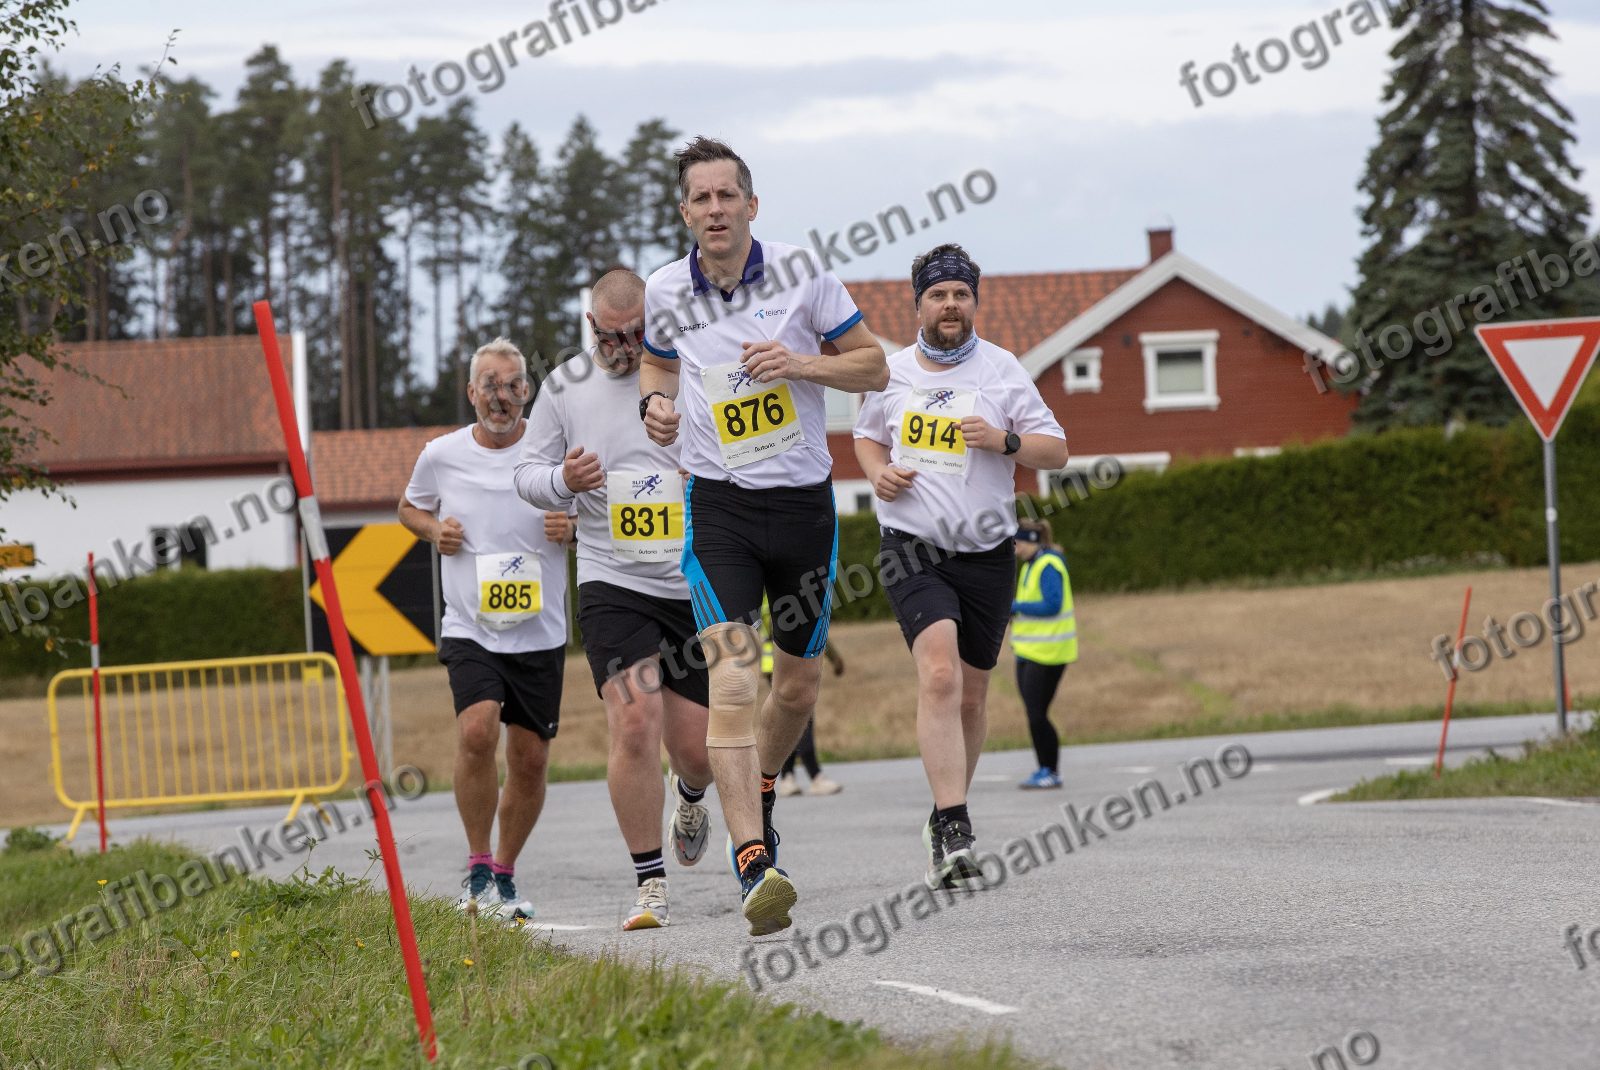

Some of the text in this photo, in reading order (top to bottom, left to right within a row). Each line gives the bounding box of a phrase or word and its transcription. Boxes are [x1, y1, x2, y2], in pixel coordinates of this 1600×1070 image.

[723, 392, 784, 437] 876
[908, 415, 957, 449] 914
[620, 506, 669, 537] 831
[488, 583, 532, 610] 885
